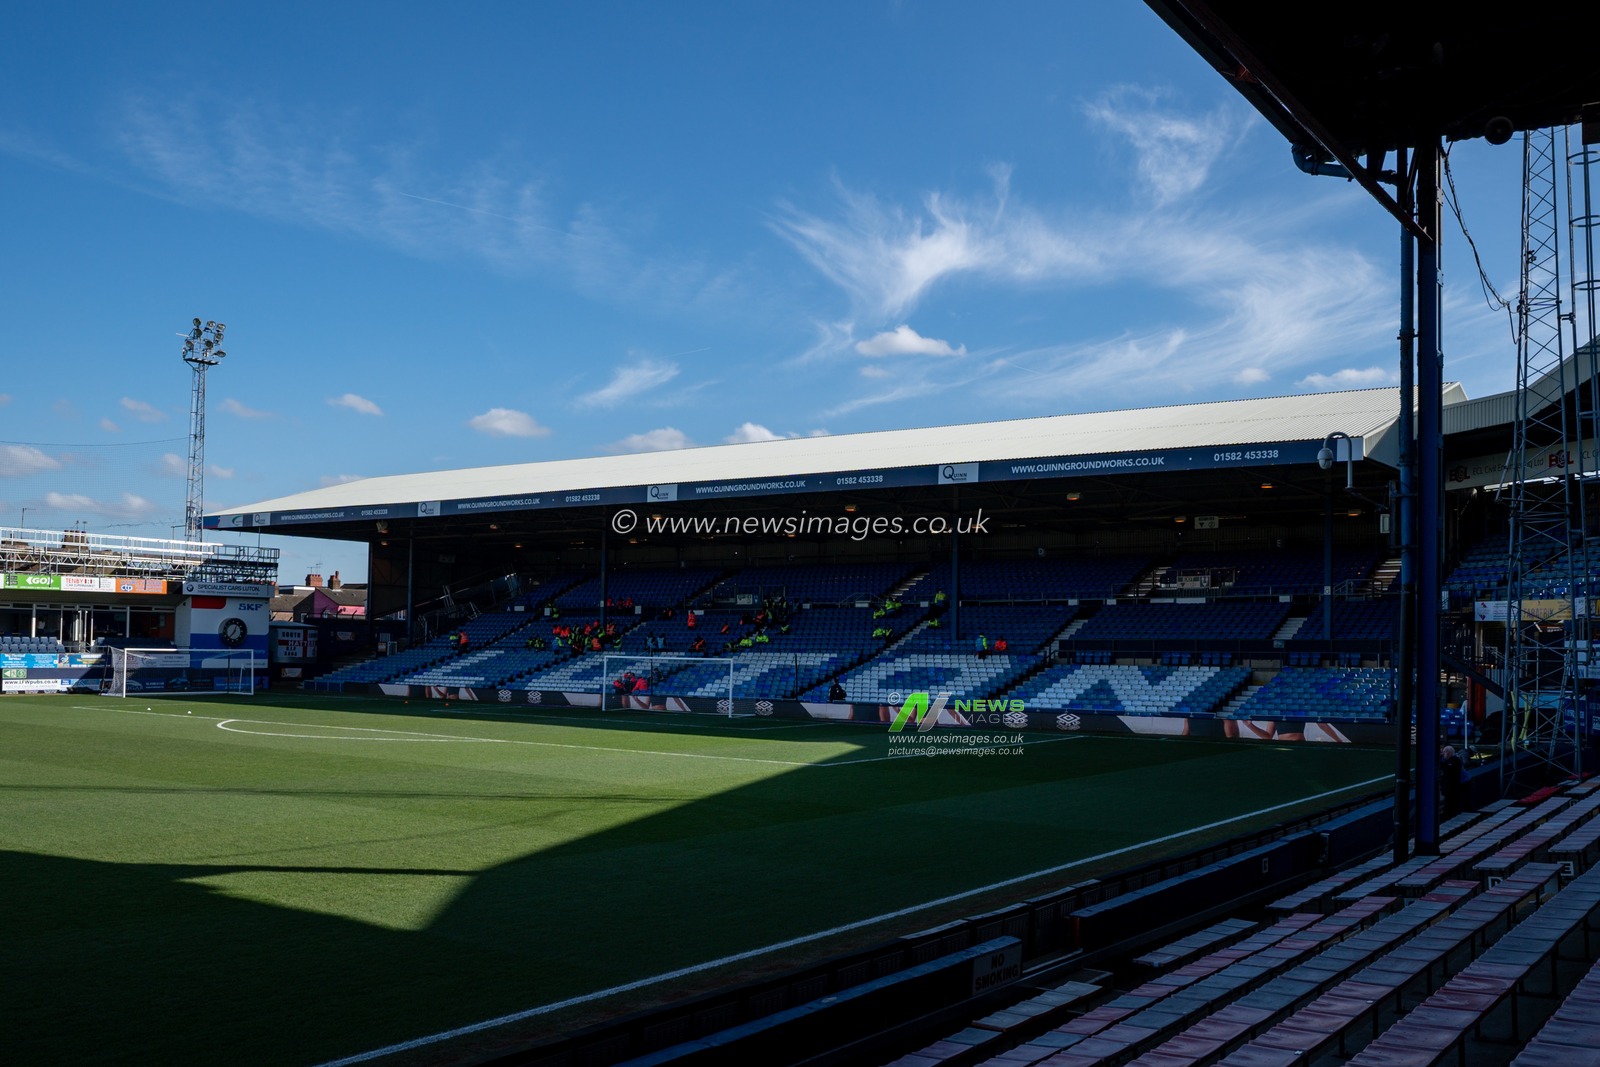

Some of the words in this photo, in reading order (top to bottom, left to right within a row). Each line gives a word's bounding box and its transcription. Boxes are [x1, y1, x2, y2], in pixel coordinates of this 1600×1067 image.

[1011, 456, 1164, 473] WWW.QUINNGROUNDWORKS.CO.UK
[1214, 452, 1242, 462] 01582
[1244, 450, 1279, 460] 453338
[943, 465, 968, 480] QUINN
[695, 480, 806, 494] WWW.QUINNGROUNDWORKS.CO.UK
[836, 476, 857, 486] 01582
[858, 475, 883, 484] 453338
[238, 603, 263, 611] SKF
[991, 953, 1005, 969] NO
[975, 963, 1018, 991] SMOKING
